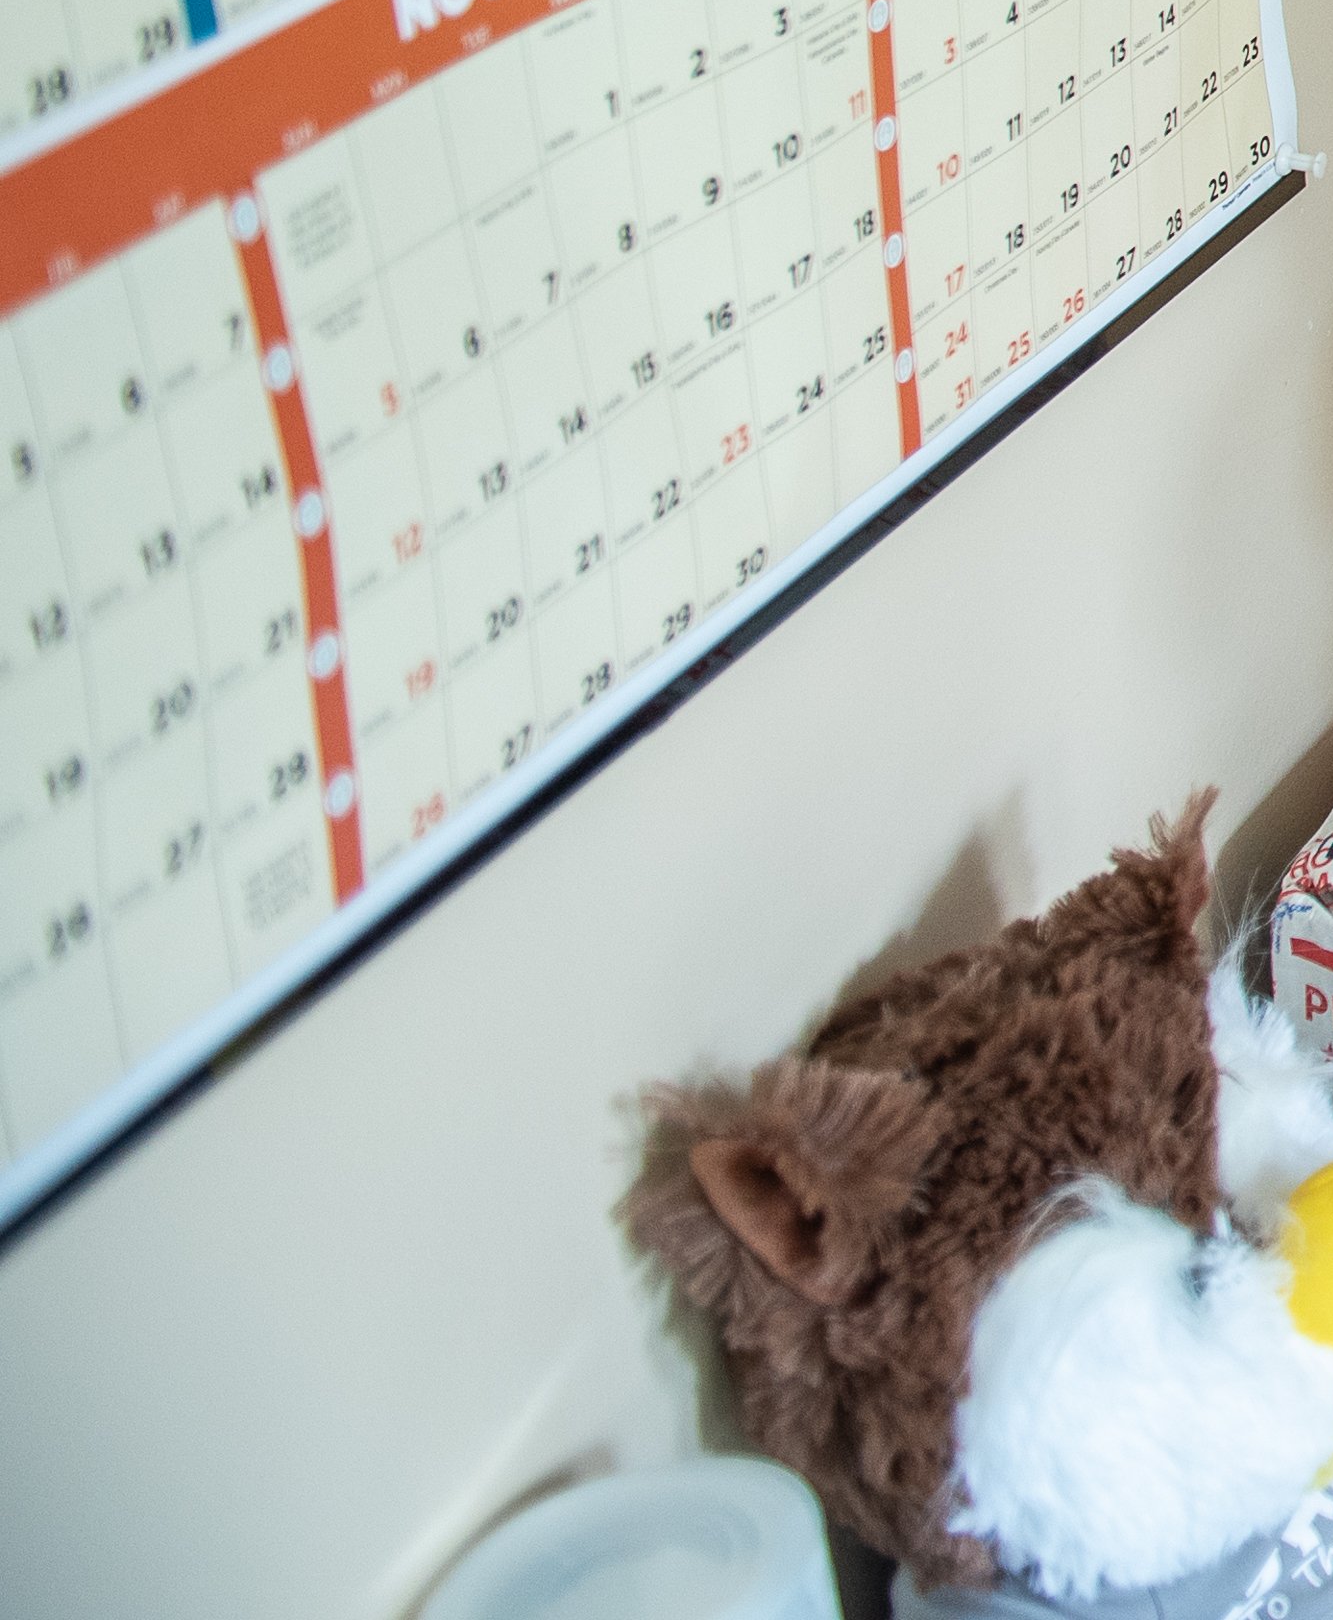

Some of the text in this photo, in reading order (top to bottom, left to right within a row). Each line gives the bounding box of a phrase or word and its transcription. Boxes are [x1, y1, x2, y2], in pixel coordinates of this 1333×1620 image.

[1007, 113, 1021, 141] 11
[1058, 75, 1075, 103] 12
[1111, 38, 1126, 67] 13
[1159, 4, 1175, 32] 14
[706, 254, 812, 336] 16 17
[1008, 331, 1030, 367] 25
[1063, 288, 1084, 323] 26
[1116, 247, 1136, 280] 27
[1167, 209, 1182, 240] 28
[1209, 171, 1228, 202] 29
[1250, 136, 1270, 165] 30
